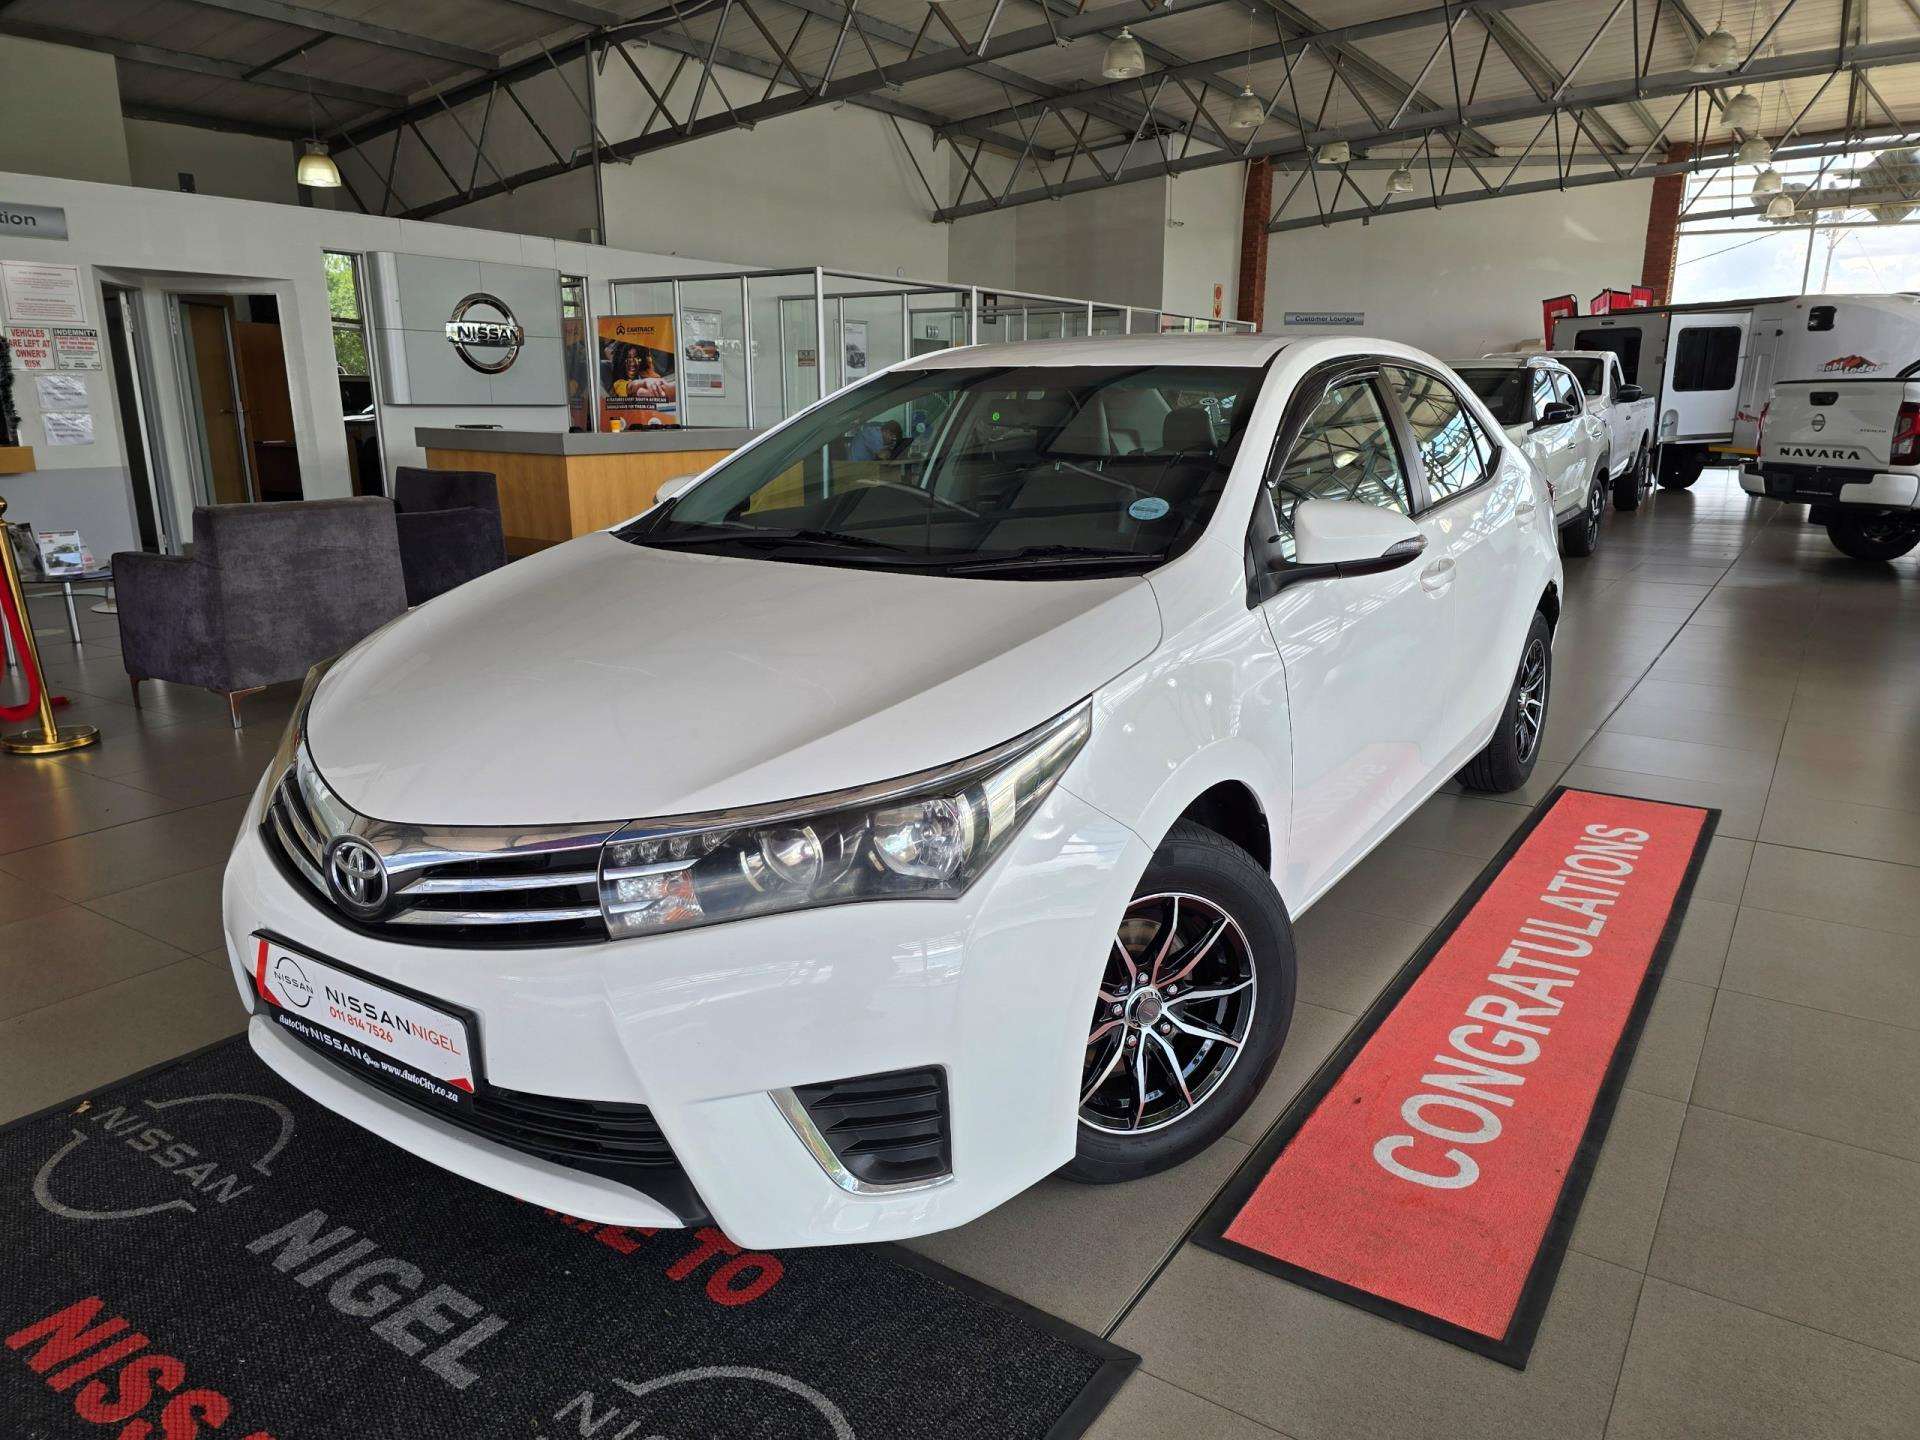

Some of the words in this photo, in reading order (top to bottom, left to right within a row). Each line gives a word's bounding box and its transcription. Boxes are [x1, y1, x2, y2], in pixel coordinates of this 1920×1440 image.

[1329, 315, 1355, 323] Lounge
[10, 328, 46, 338] VEHICLES
[53, 328, 97, 336] INDEMNITY
[457, 325, 519, 341] NISSAN
[24, 339, 40, 348] LEFT
[42, 340, 51, 348] AT
[15, 349, 47, 358] OWNER'S
[24, 360, 42, 368] RISK
[1779, 447, 1861, 460] NAVARA
[273, 970, 314, 994] NISSAN
[1372, 824, 1650, 1190] CONGRATULATIONS
[329, 1006, 345, 1022] 011
[347, 1014, 366, 1031] 814
[367, 1021, 394, 1043] 7526
[279, 1014, 310, 1037] AutoCity
[310, 1028, 363, 1060] NISSAN
[380, 1061, 459, 1103] www.AutoCity.co.za
[91, 1105, 254, 1203] NISSAN
[665, 1226, 785, 1307] TO
[245, 1208, 510, 1391] NIGEL
